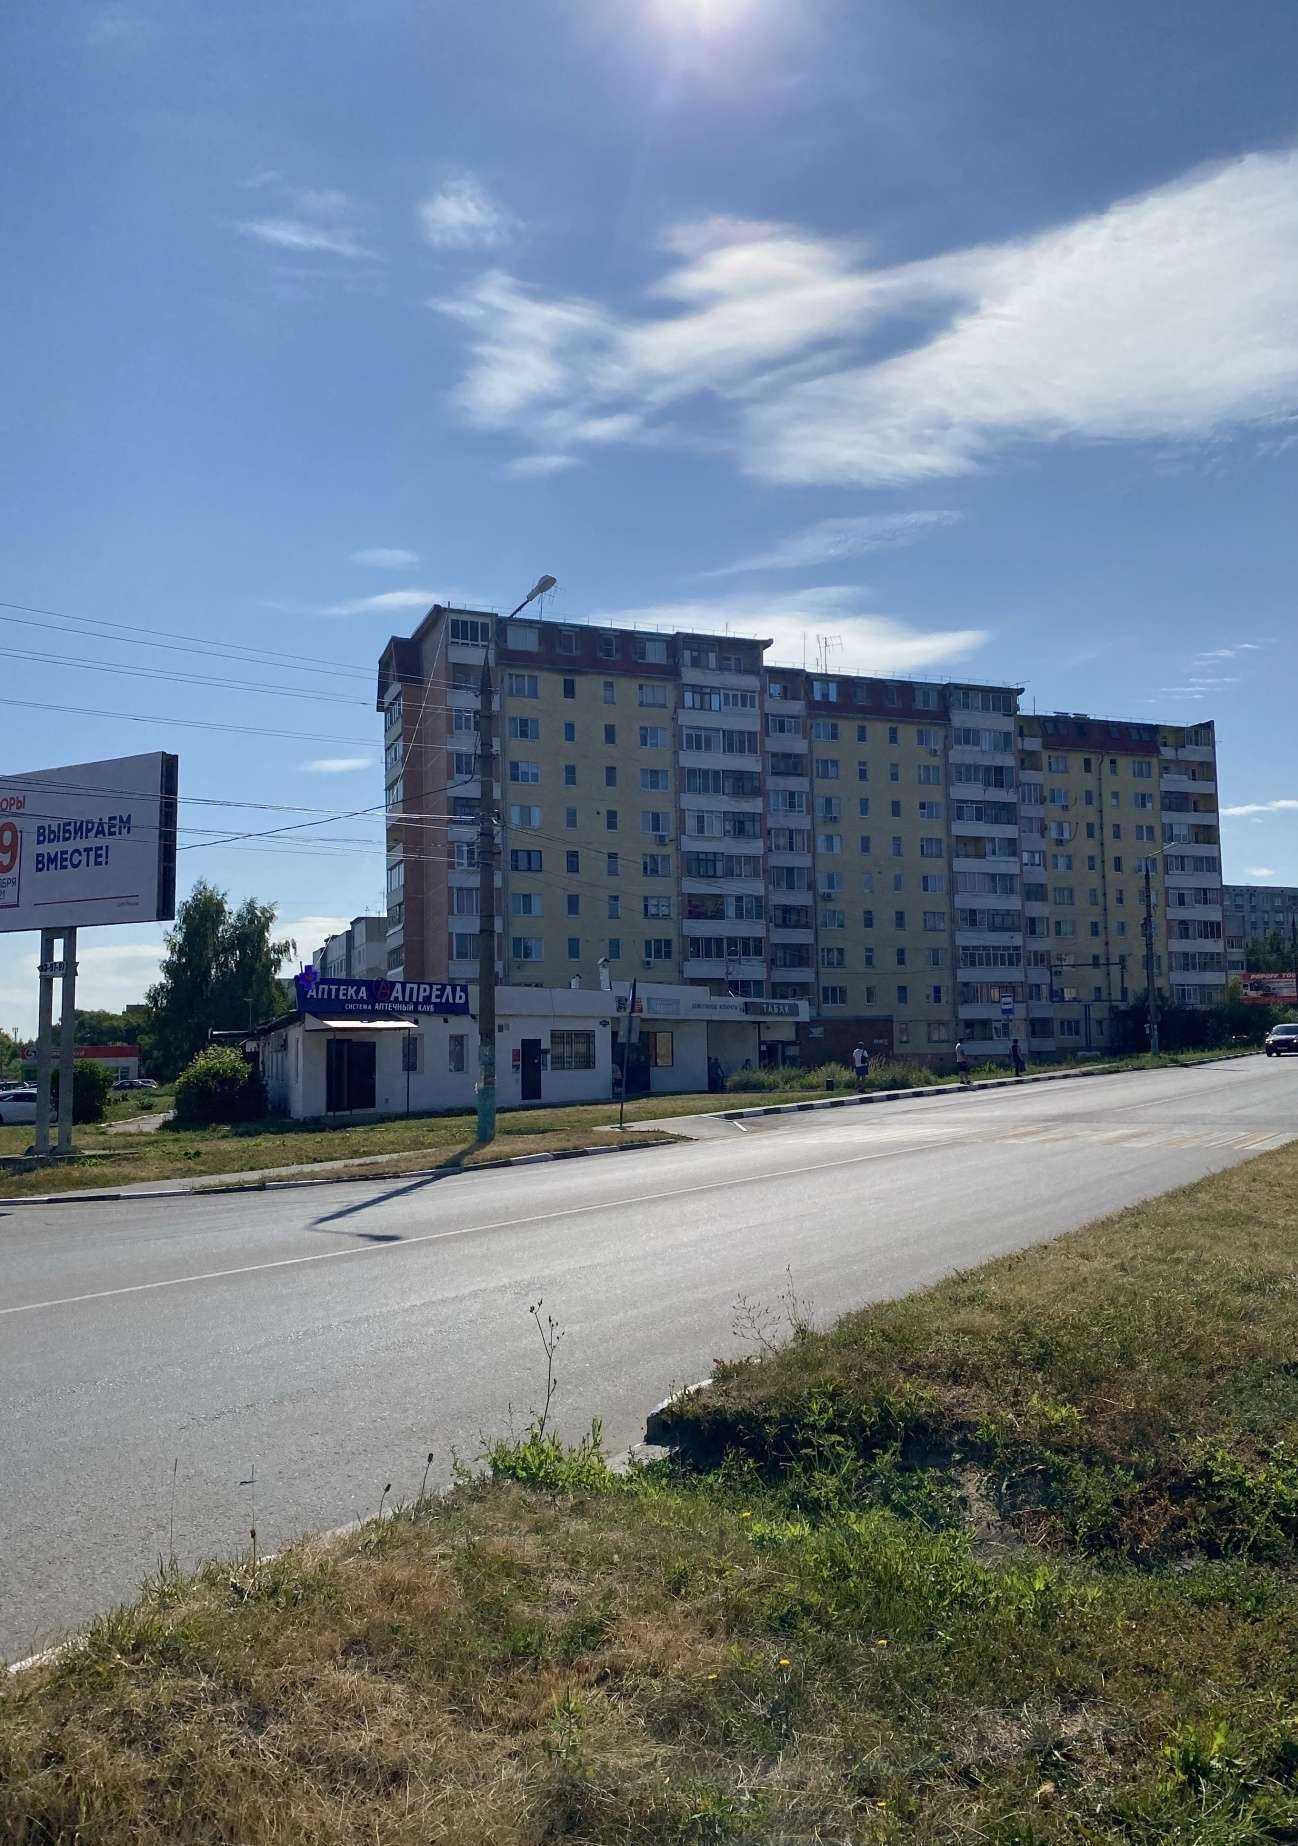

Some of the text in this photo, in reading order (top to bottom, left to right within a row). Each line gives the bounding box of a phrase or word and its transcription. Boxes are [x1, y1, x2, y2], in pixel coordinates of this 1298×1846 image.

[36, 814, 132, 845] ВЫБИРАЕМ
[35, 845, 110, 873] ВМЕСТЕ!
[306, 984, 368, 1000] АПТЕКА
[390, 983, 467, 1004] АПРЕЛЬ
[345, 1002, 436, 1013] СИСТЕМА АПТЕЧНЫЙ КЛУБ
